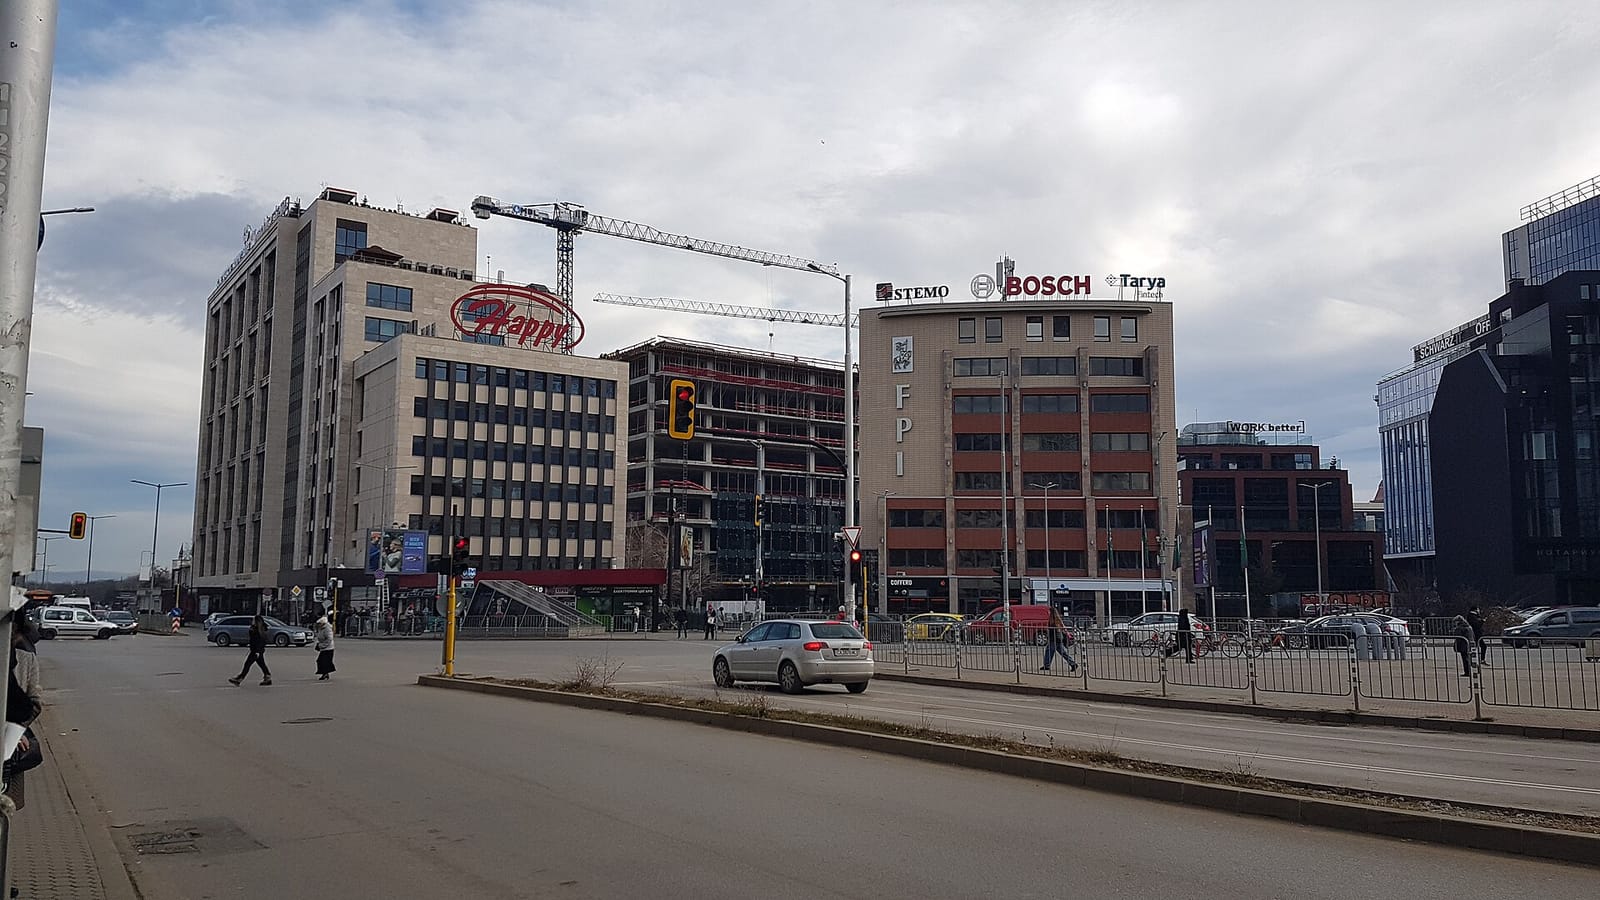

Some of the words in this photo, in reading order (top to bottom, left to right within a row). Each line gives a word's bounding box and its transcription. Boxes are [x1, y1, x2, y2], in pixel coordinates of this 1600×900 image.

[1006, 275, 1091, 296] BOSCH
[1119, 273, 1166, 290] Tarya
[894, 285, 949, 300] STEMO
[469, 299, 571, 348] Happy
[1419, 335, 1455, 359] SCHWARZ
[1455, 332, 1463, 345] IT
